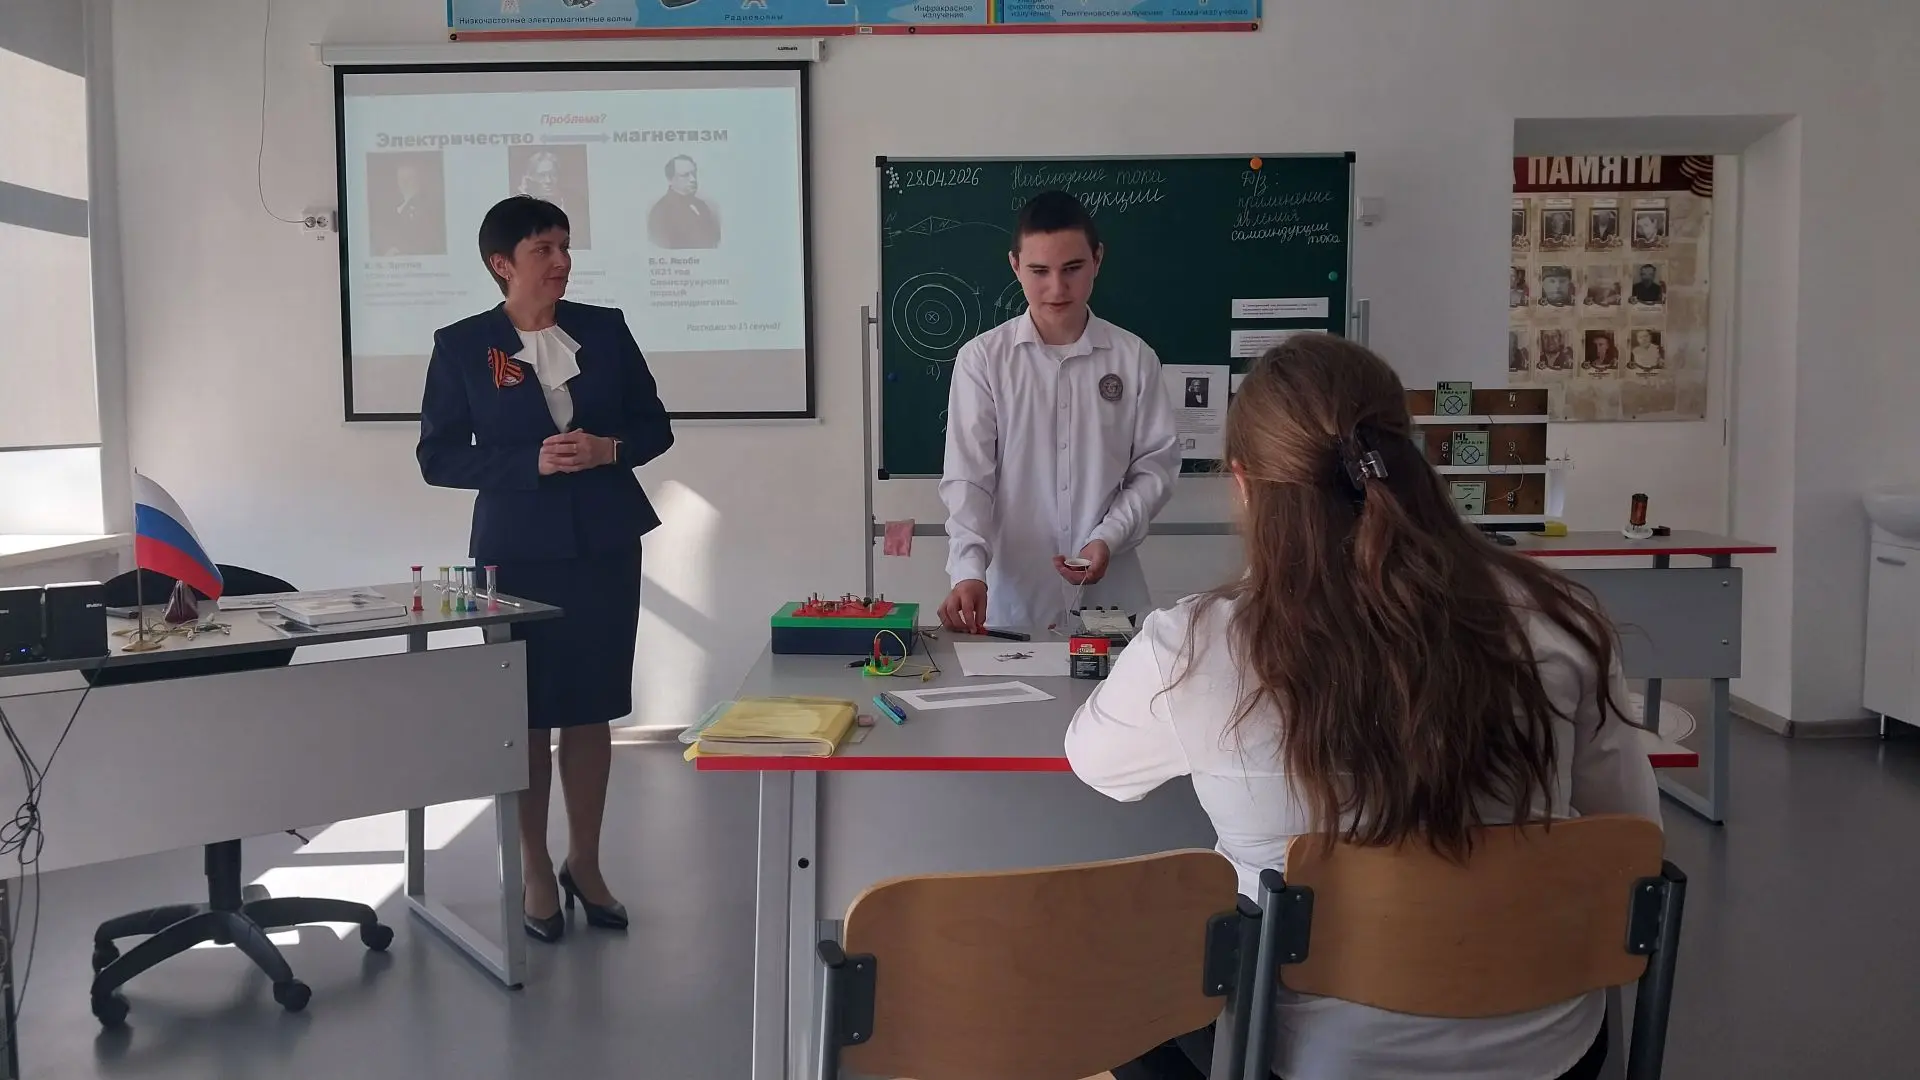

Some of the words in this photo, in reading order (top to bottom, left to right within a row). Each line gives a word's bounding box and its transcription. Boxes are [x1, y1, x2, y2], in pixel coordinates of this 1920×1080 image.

[913, 4, 973, 12] Инфракрасное
[724, 13, 784, 21] Радиоволны
[1061, 9, 1120, 17] Рентгеновское
[459, 16, 526, 25] Низкочастотные
[528, 15, 605, 24] электромагнитные
[606, 15, 633, 23] волны
[540, 113, 608, 127] Проблема?
[376, 131, 534, 148] Электричество
[613, 128, 729, 144] магнетизм
[1527, 155, 1662, 185] ПАМЯТИ
[906, 167, 983, 188] 28.04.2026
[1438, 382, 1452, 391] HL
[1455, 432, 1469, 441] HL
